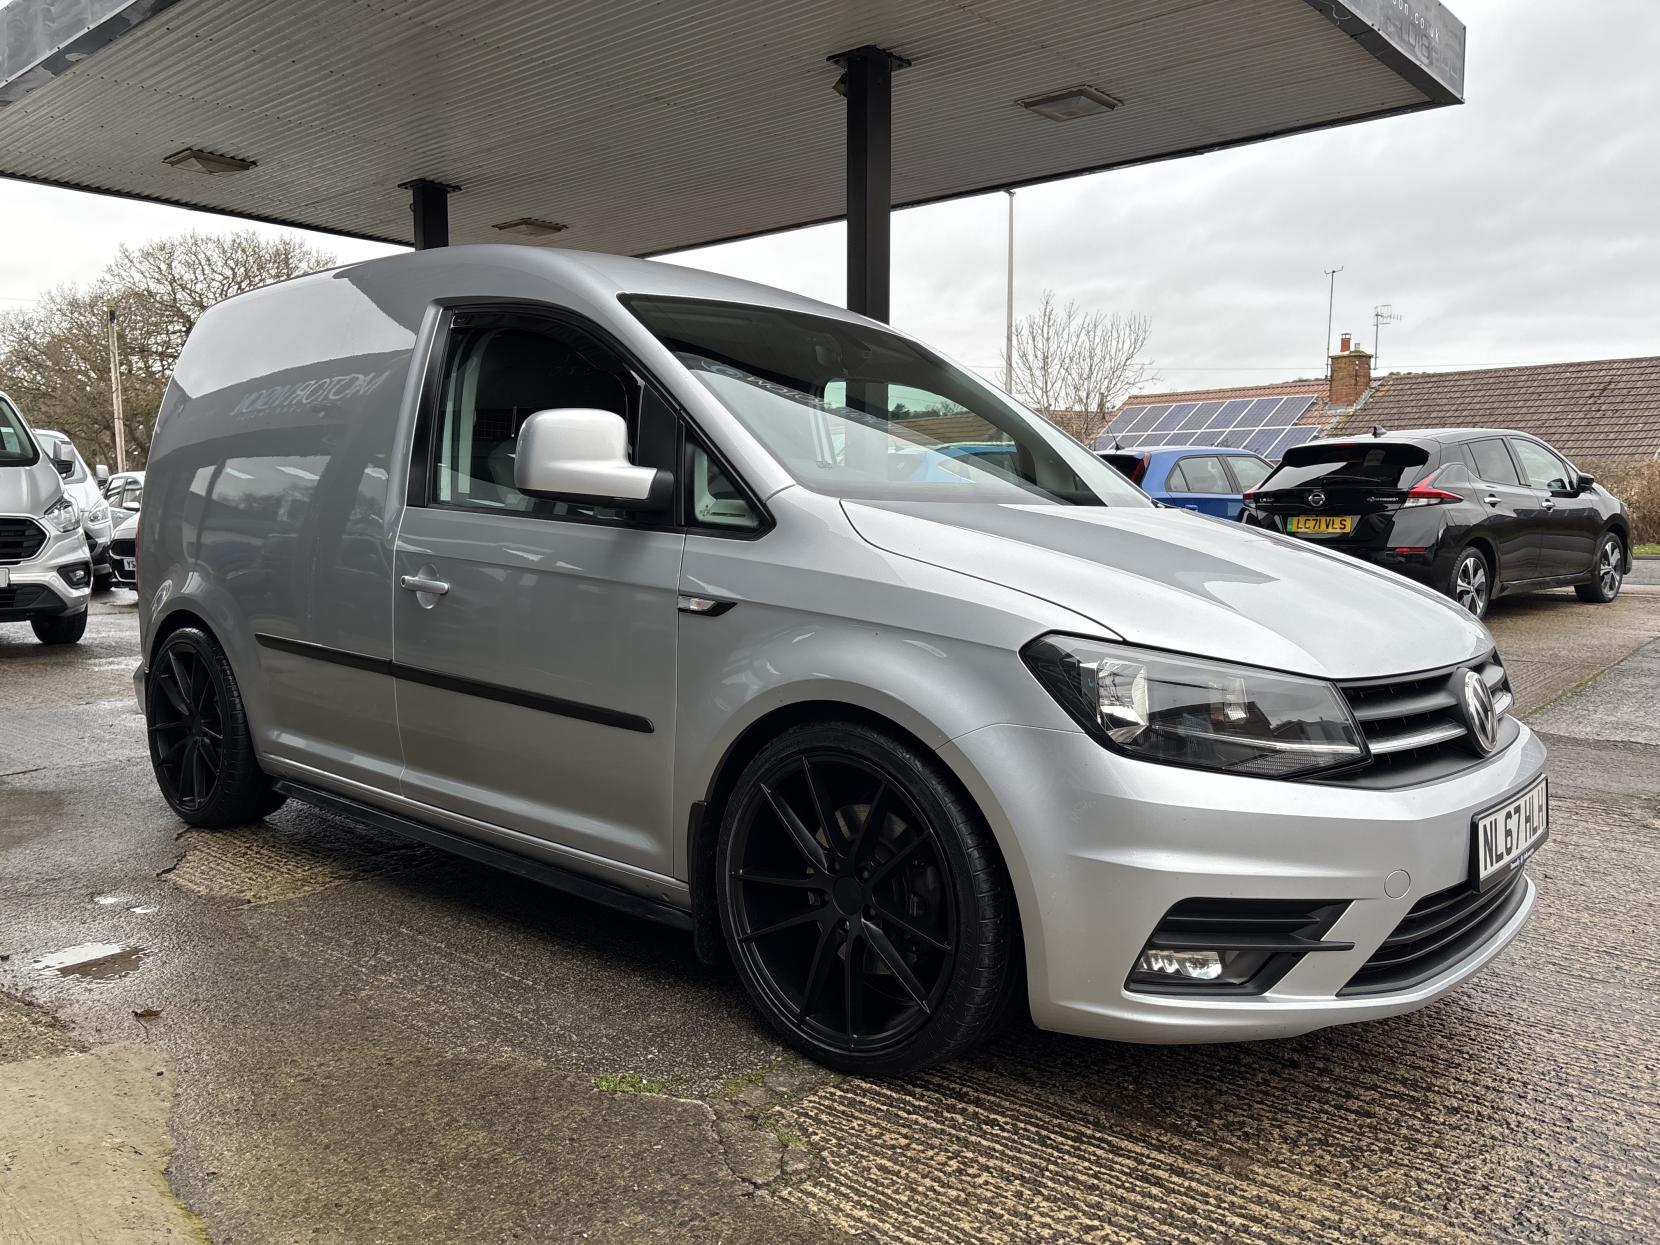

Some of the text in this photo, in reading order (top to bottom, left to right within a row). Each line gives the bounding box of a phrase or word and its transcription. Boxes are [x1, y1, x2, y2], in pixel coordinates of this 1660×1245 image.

[1296, 518, 1347, 530] LC71 VLS
[1483, 803, 1521, 872] NL67
